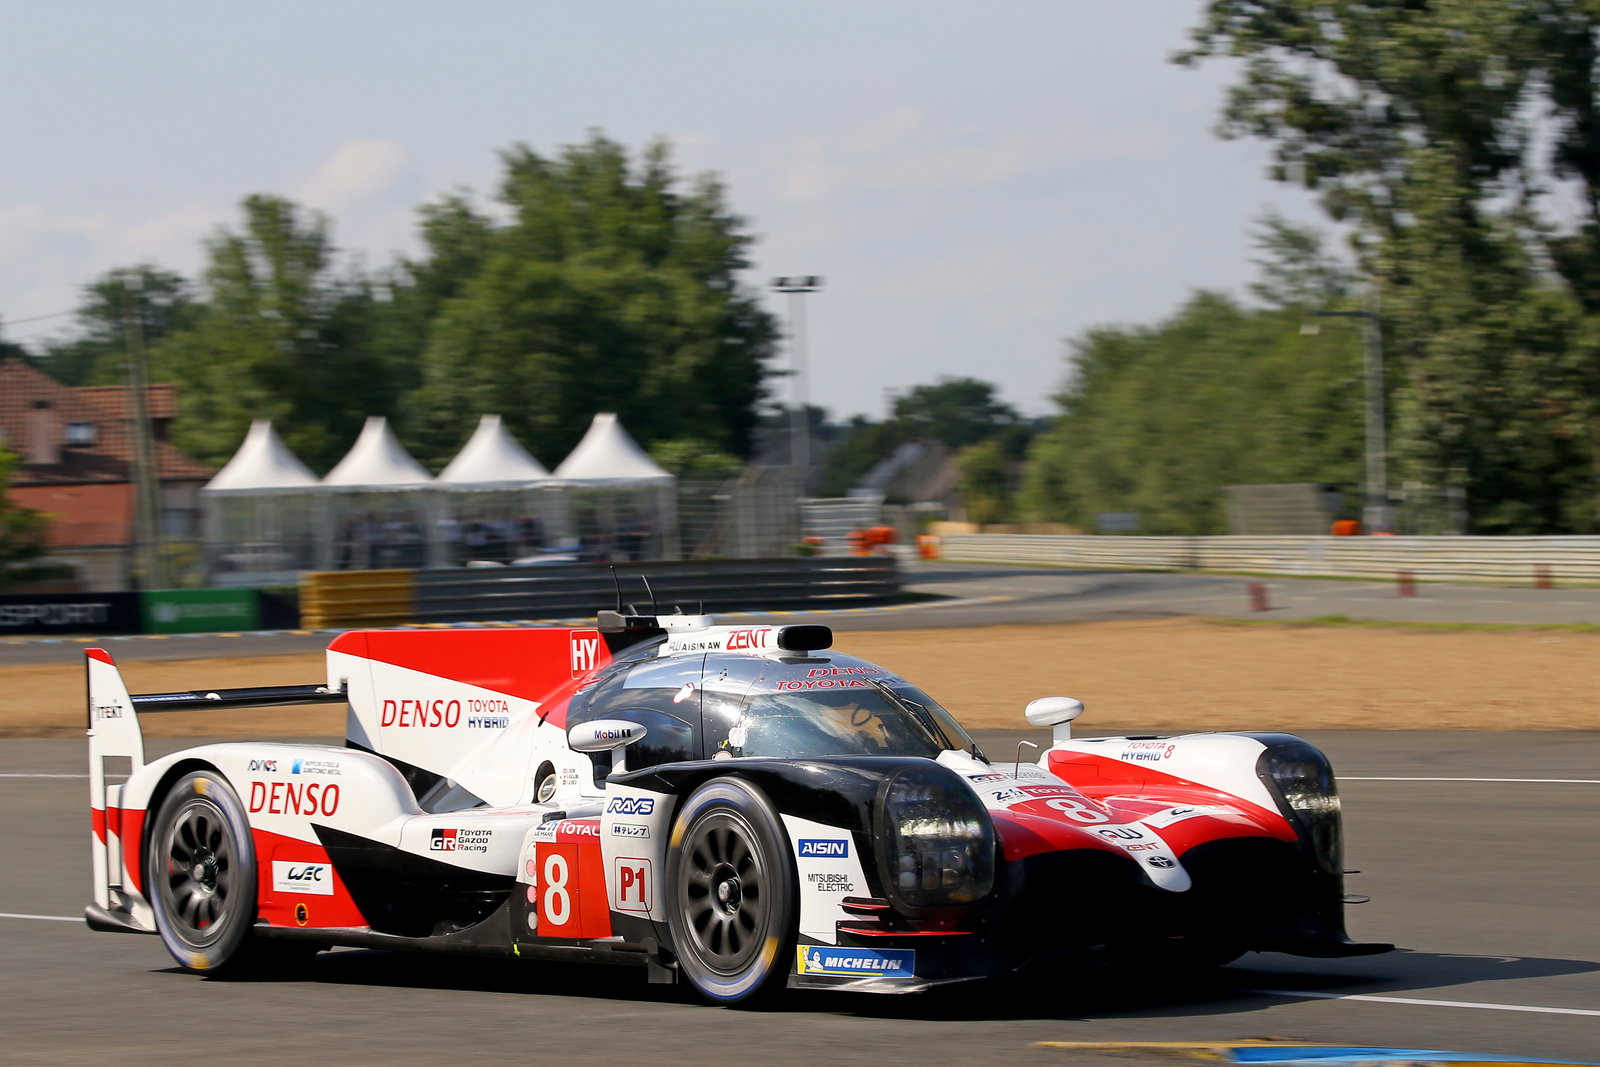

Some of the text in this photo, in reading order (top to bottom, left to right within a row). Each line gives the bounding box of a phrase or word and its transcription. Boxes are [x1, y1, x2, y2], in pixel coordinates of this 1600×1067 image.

[682, 642, 705, 651] AISIN
[708, 641, 720, 650] AW
[726, 628, 772, 651] ZENT
[571, 638, 598, 671] HY
[776, 679, 866, 692] TOYOTA
[467, 699, 510, 713] TOYOTA
[380, 699, 461, 728] DENSO
[467, 716, 510, 729] HYBRID
[594, 729, 620, 739] Mobil
[1120, 751, 1162, 762] HYBRID
[1127, 742, 1176, 759] TOYOTA 8
[249, 781, 340, 817] DENSO
[607, 796, 655, 815] RAYS
[1045, 797, 1110, 824] 8
[459, 828, 493, 836] TOYOTA
[560, 821, 600, 837] TOTAL
[613, 825, 648, 836] 林テレンプ
[430, 837, 457, 850] GR
[458, 836, 489, 844] GAZOO
[457, 844, 488, 853] Racing
[802, 842, 845, 855] AISIN
[1124, 842, 1161, 852] ZENT
[287, 865, 324, 882] WEC
[807, 873, 848, 883] MITSUBISHI
[544, 854, 570, 925] 8
[620, 866, 645, 903] P1
[817, 883, 854, 892] ELECTRIC
[824, 956, 902, 970] MICHELIN
